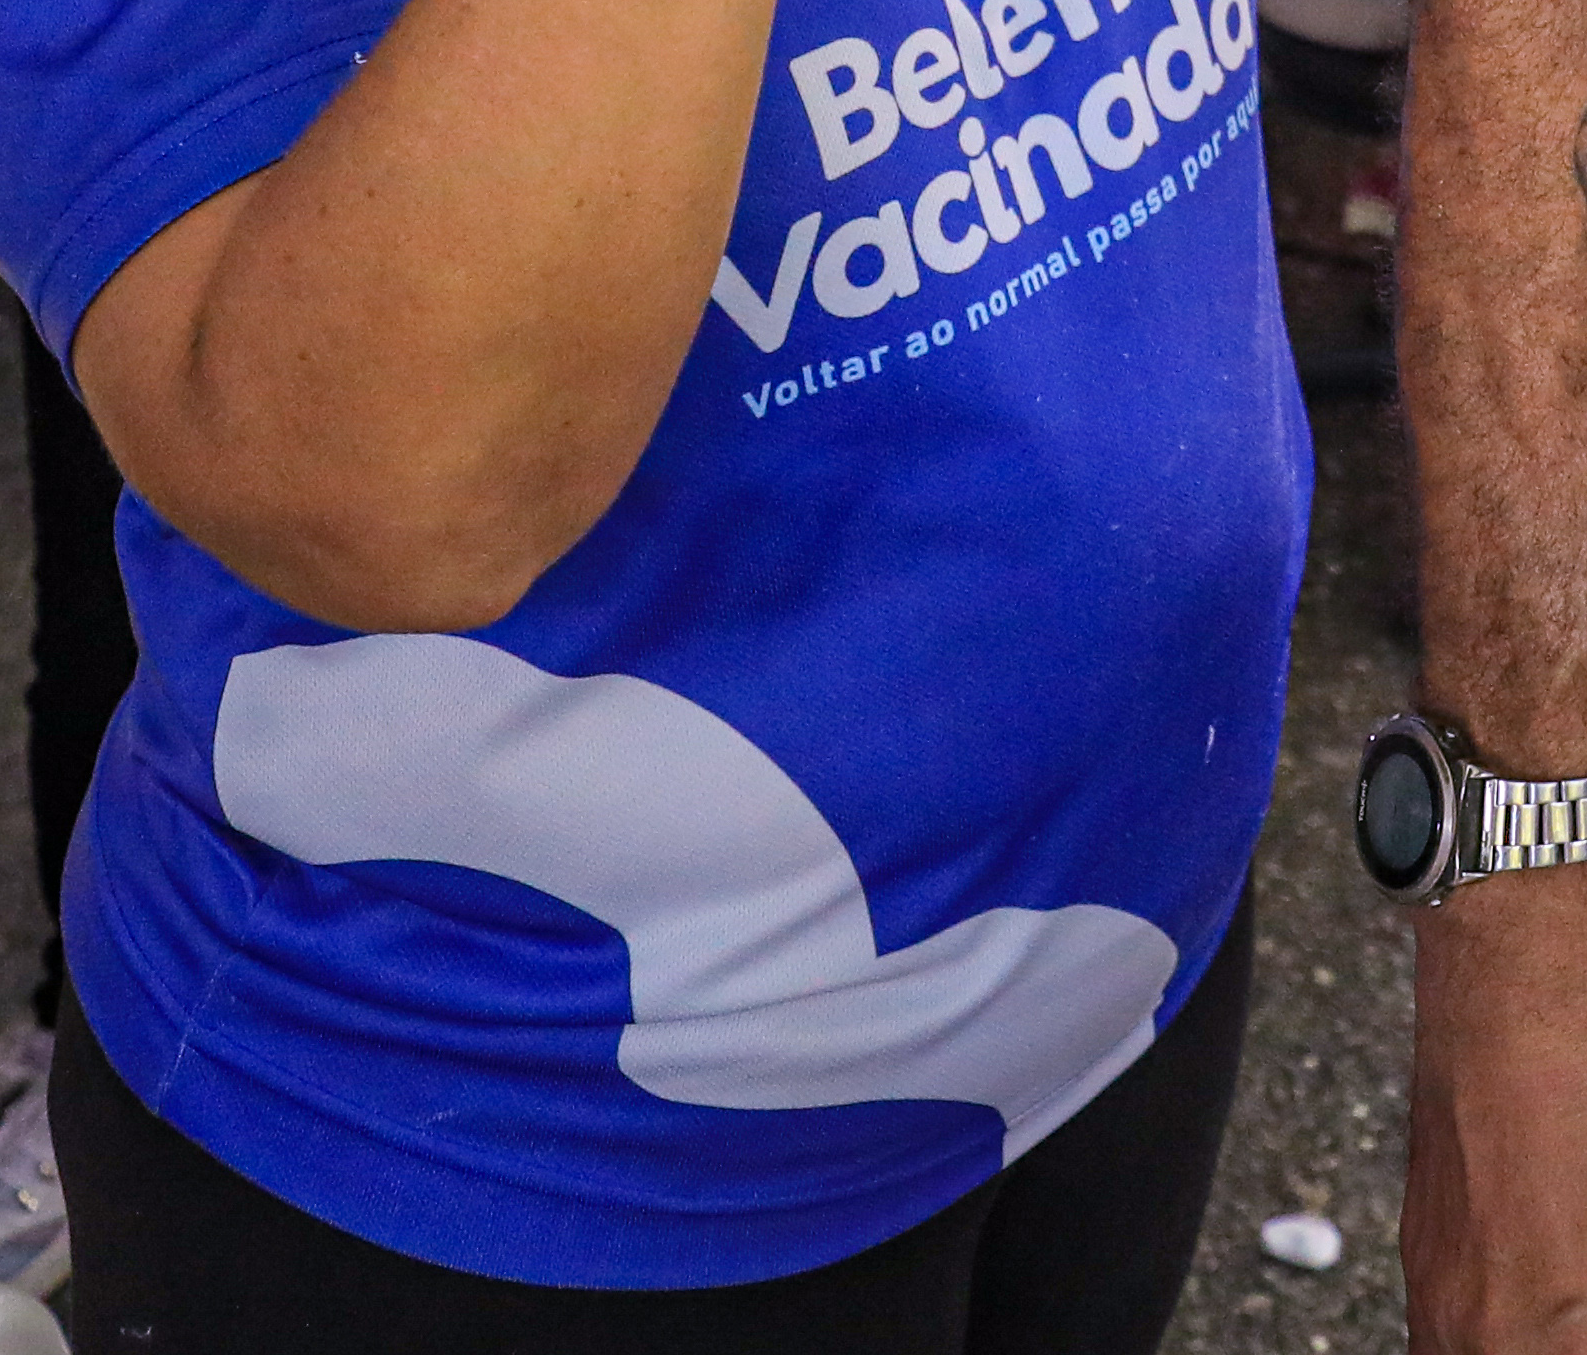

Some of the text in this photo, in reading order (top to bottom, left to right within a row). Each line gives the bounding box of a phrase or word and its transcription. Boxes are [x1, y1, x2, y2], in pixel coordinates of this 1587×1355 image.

[742, 345, 889, 419] Voltar
[904, 318, 955, 358] ao
[966, 235, 1081, 331] normal
[1087, 175, 1178, 263] passa
[1181, 129, 1222, 192] por
